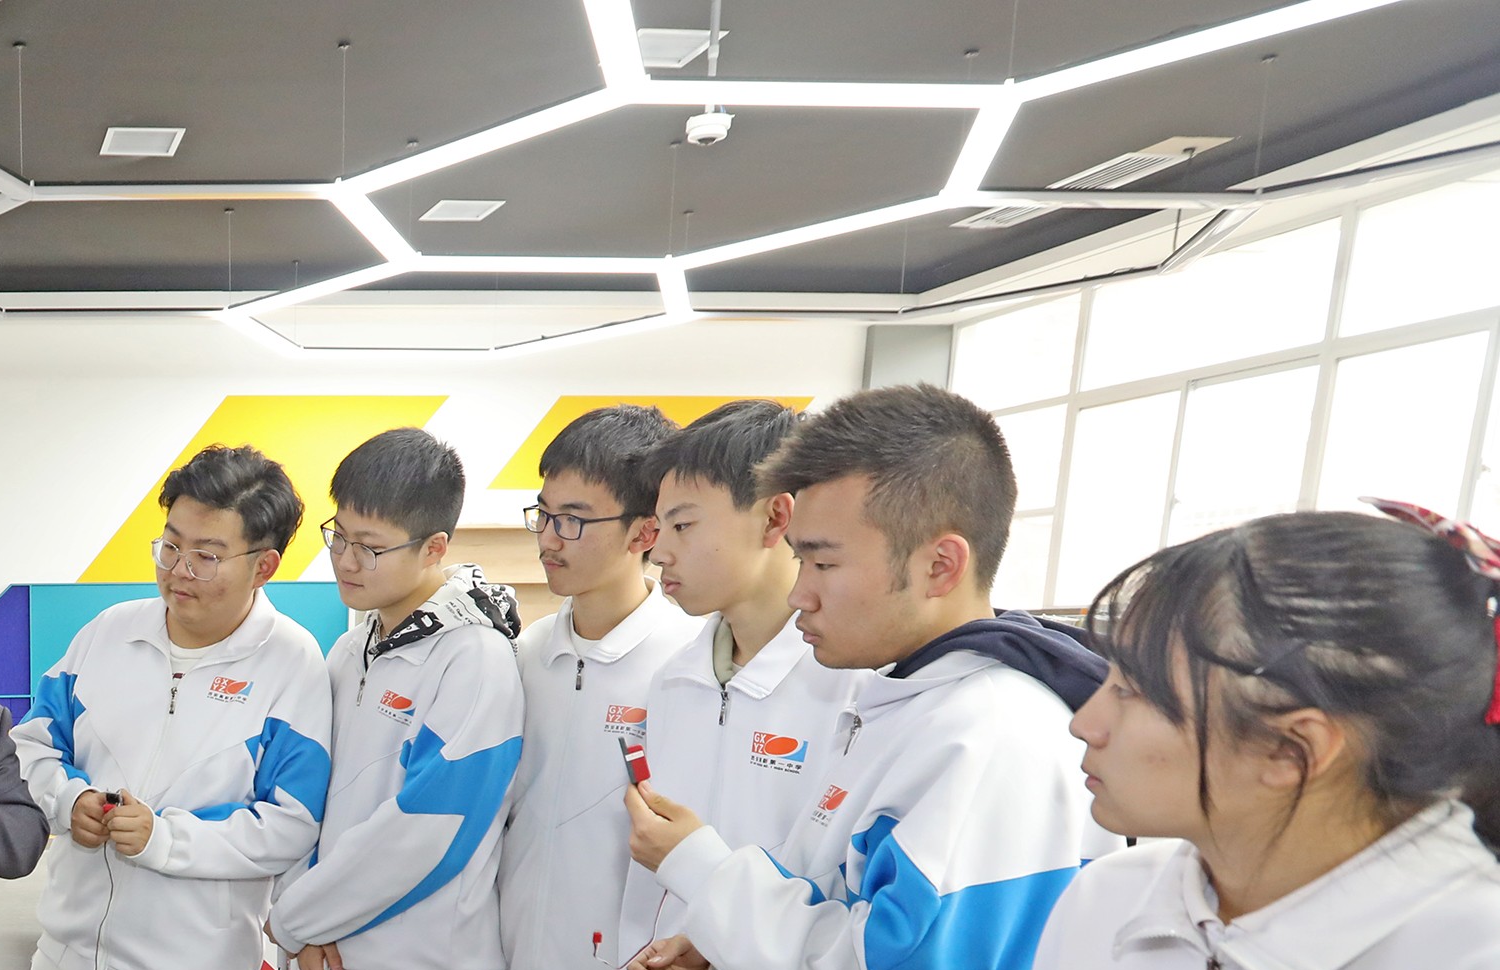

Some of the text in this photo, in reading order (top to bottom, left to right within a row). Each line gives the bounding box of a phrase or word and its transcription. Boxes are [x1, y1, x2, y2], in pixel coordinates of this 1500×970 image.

[214, 677, 228, 686] GX
[212, 684, 226, 692] YZ
[609, 706, 624, 715] GX
[607, 714, 622, 722] YZ
[754, 733, 766, 744] GX
[753, 743, 764, 754] YZ
